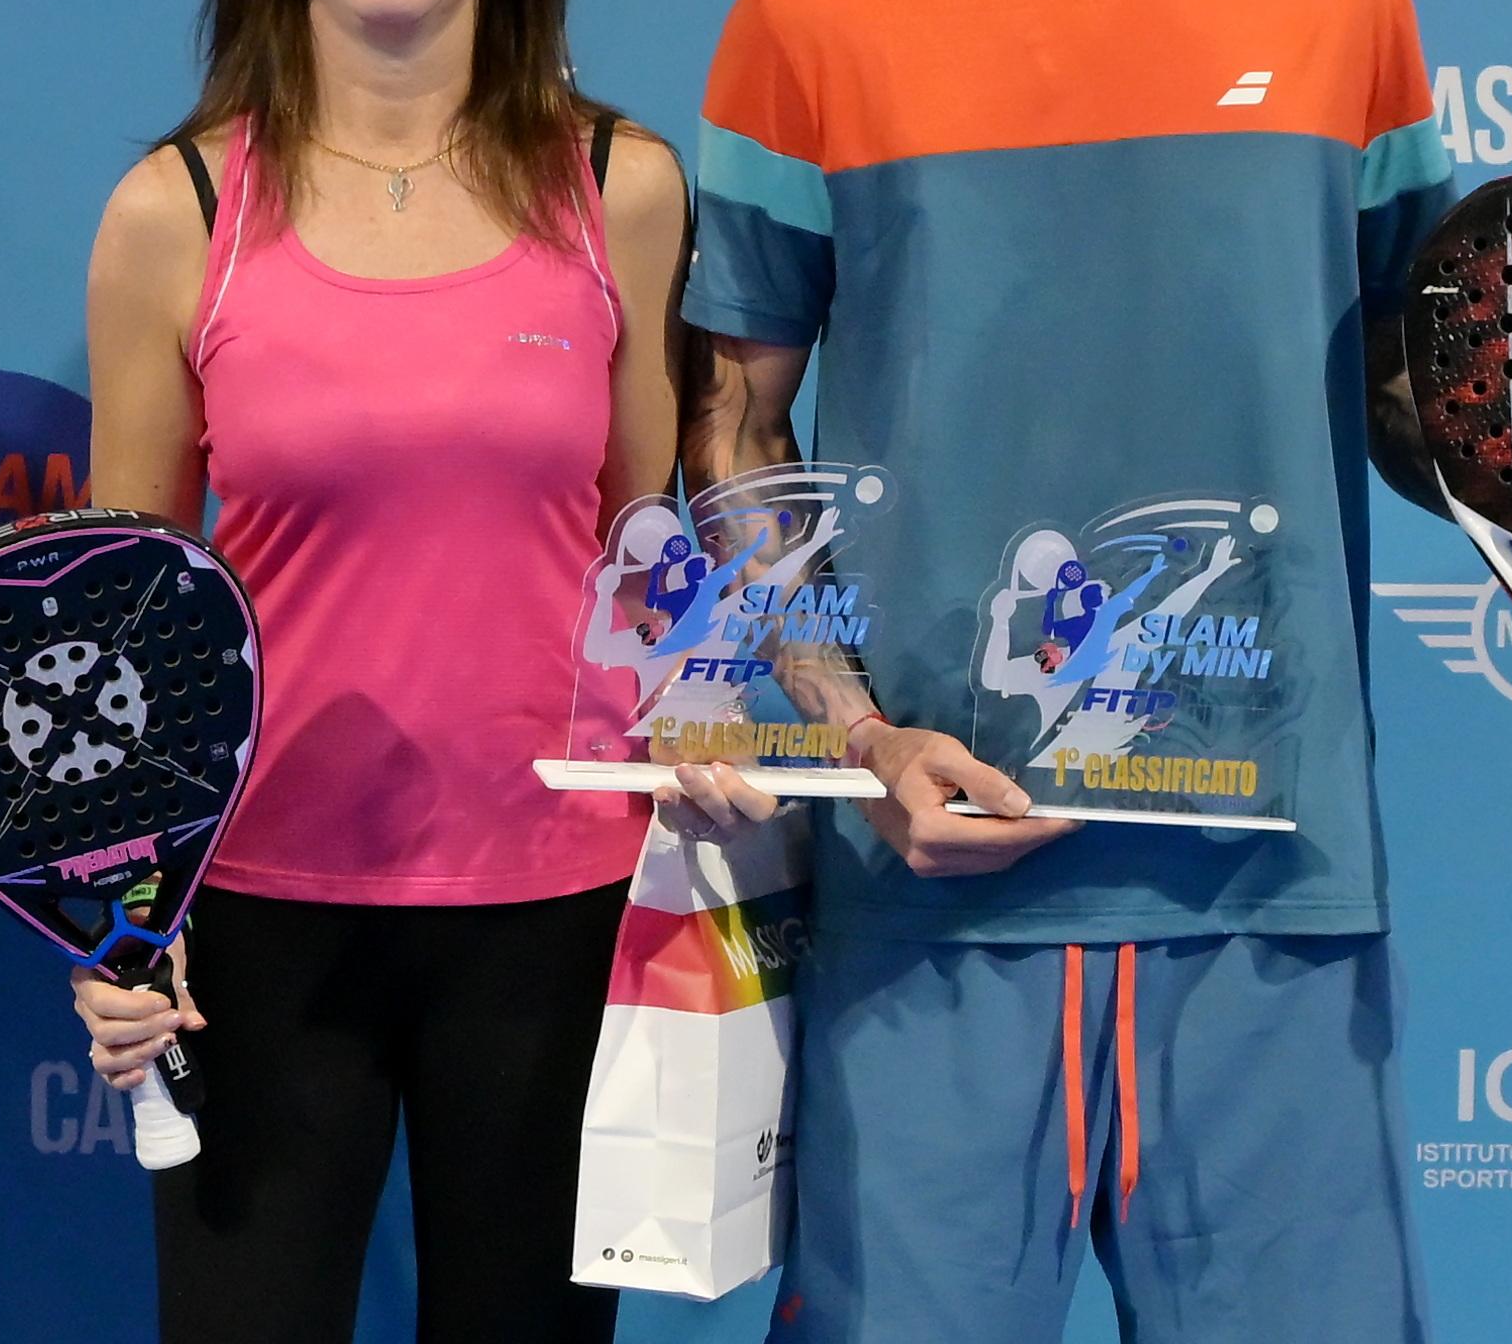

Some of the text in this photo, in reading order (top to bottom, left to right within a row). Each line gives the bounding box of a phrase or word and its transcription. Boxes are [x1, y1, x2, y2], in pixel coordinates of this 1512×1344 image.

[17, 551, 60, 572] PWR
[739, 584, 860, 616] SLAM
[779, 615, 871, 646] MINI
[1138, 613, 1260, 648] SLAM
[680, 657, 774, 684] FITP
[1180, 647, 1273, 679] MINI
[1081, 687, 1177, 716] FITP
[680, 720, 849, 758] CLASSIFICATO
[1083, 752, 1258, 797] CLASSIFICATO
